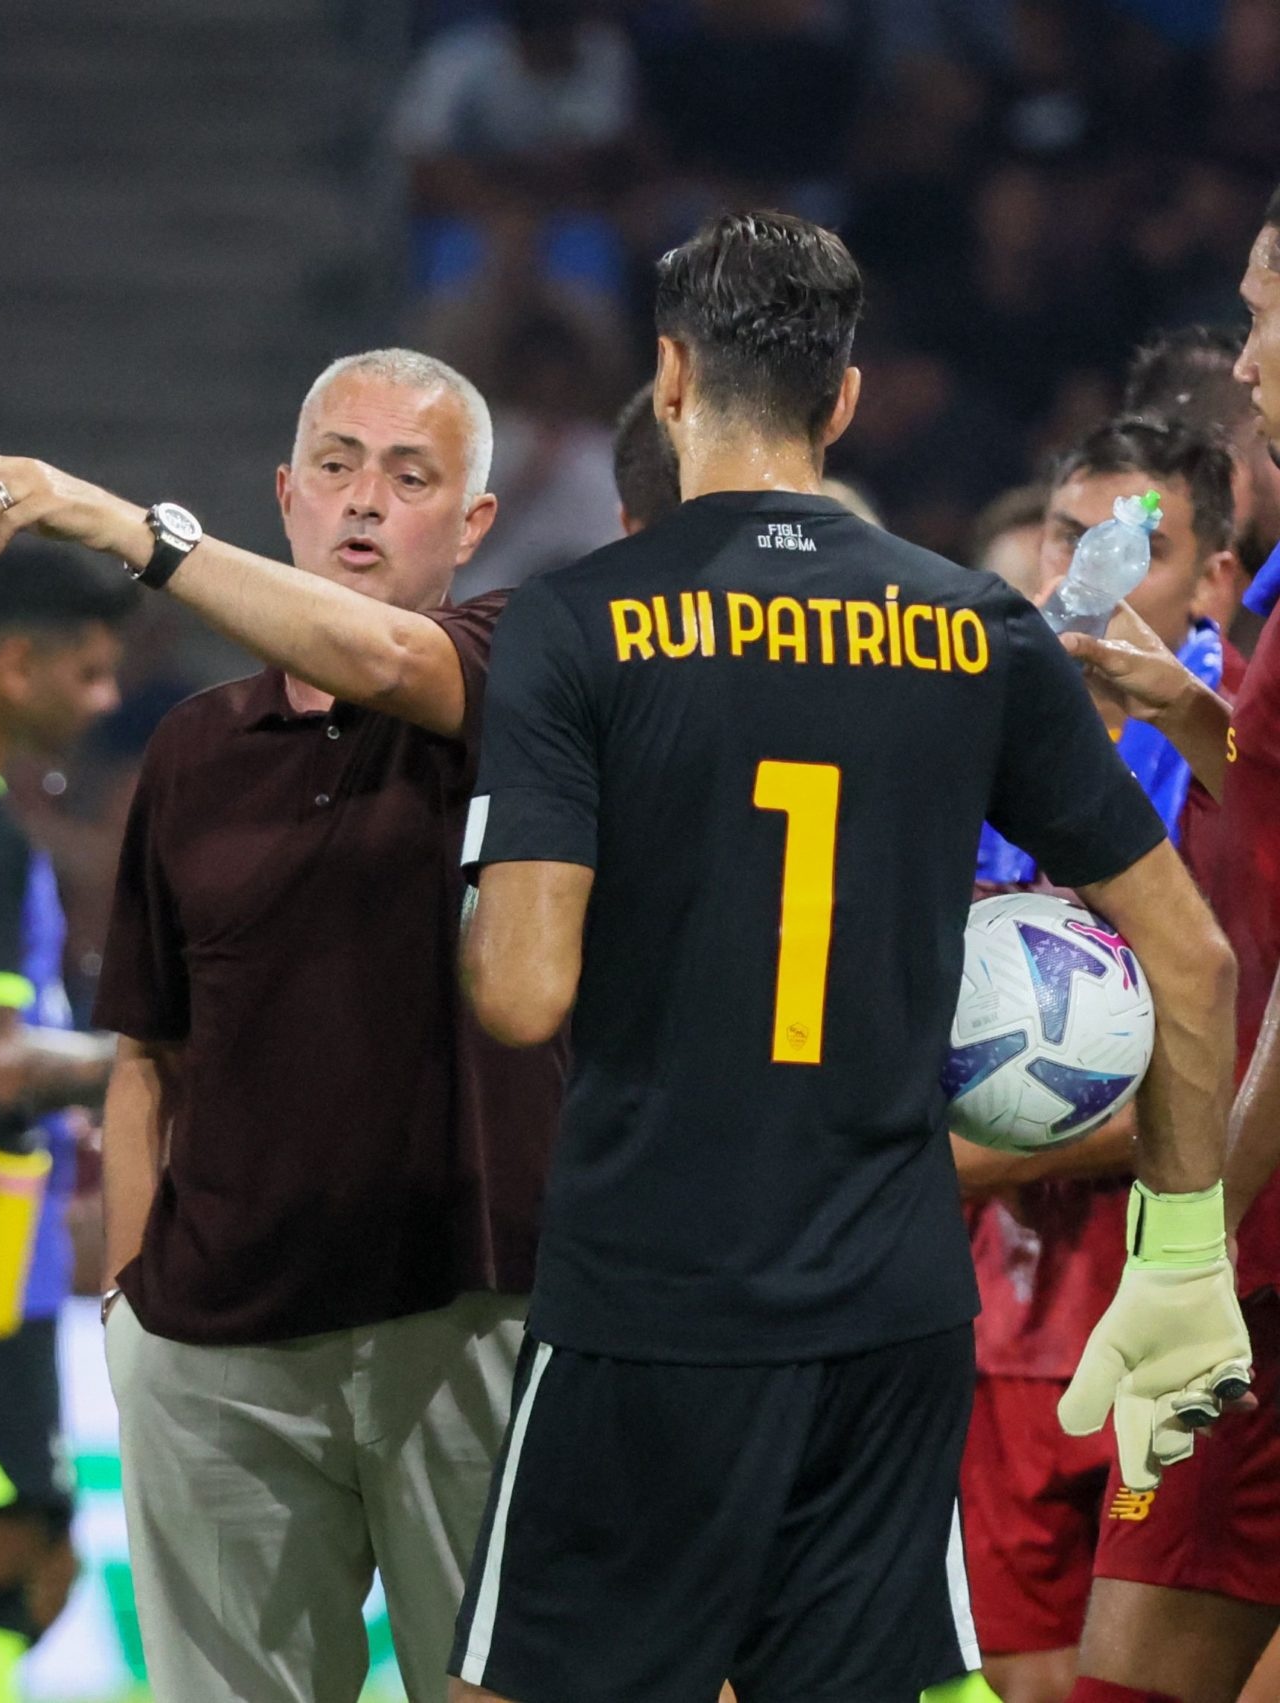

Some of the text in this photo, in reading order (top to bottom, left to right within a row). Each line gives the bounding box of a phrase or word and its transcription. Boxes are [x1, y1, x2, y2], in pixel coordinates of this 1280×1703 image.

[757, 534, 817, 552] DI ROMA
[767, 523, 803, 538] FIGLI
[608, 584, 990, 674] RUI PATRÍCIO
[752, 760, 841, 1064] 1
